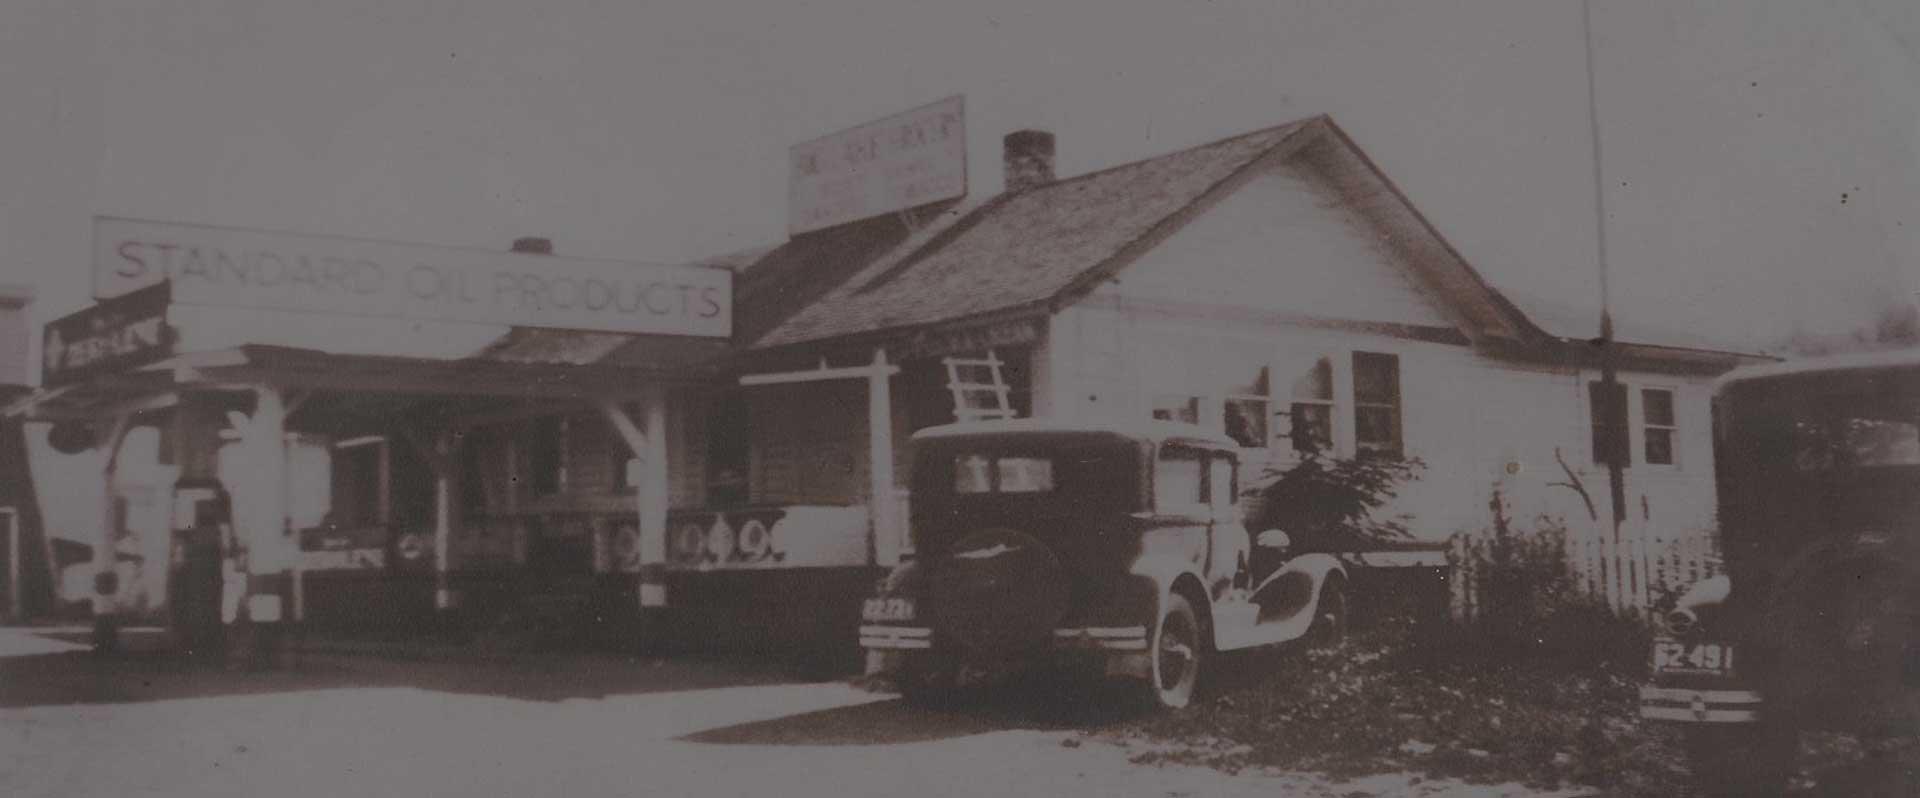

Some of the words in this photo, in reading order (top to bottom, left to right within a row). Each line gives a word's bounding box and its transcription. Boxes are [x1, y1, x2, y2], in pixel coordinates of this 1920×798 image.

[116, 240, 385, 296] STANDARD
[405, 265, 478, 304] OIL
[493, 271, 723, 319] PRODUCTS
